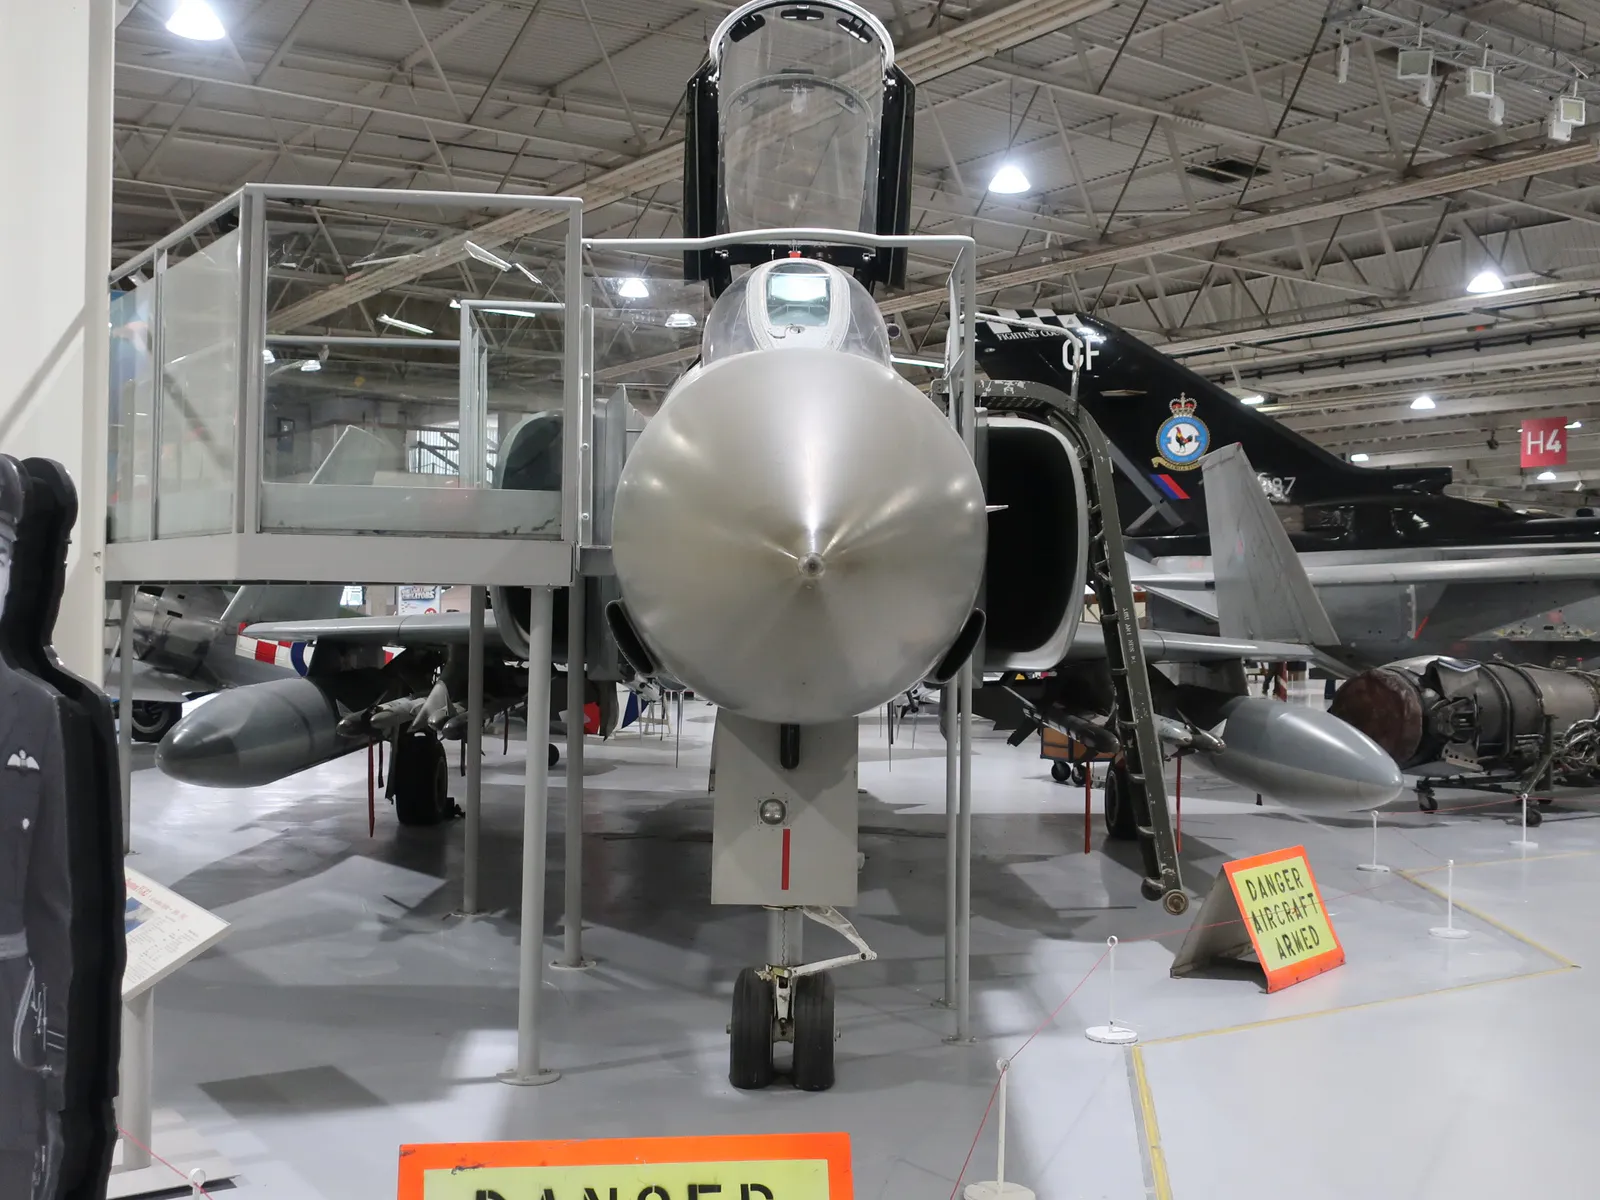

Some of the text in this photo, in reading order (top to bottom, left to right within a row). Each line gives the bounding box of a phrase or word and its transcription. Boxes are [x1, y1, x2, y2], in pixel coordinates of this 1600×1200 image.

[997, 330, 1039, 341] FIGHTING
[1526, 428, 1562, 456] H4
[1245, 867, 1304, 902] DANGER
[1251, 892, 1318, 935] AIRCRAFT
[1275, 925, 1320, 960] ARMED
